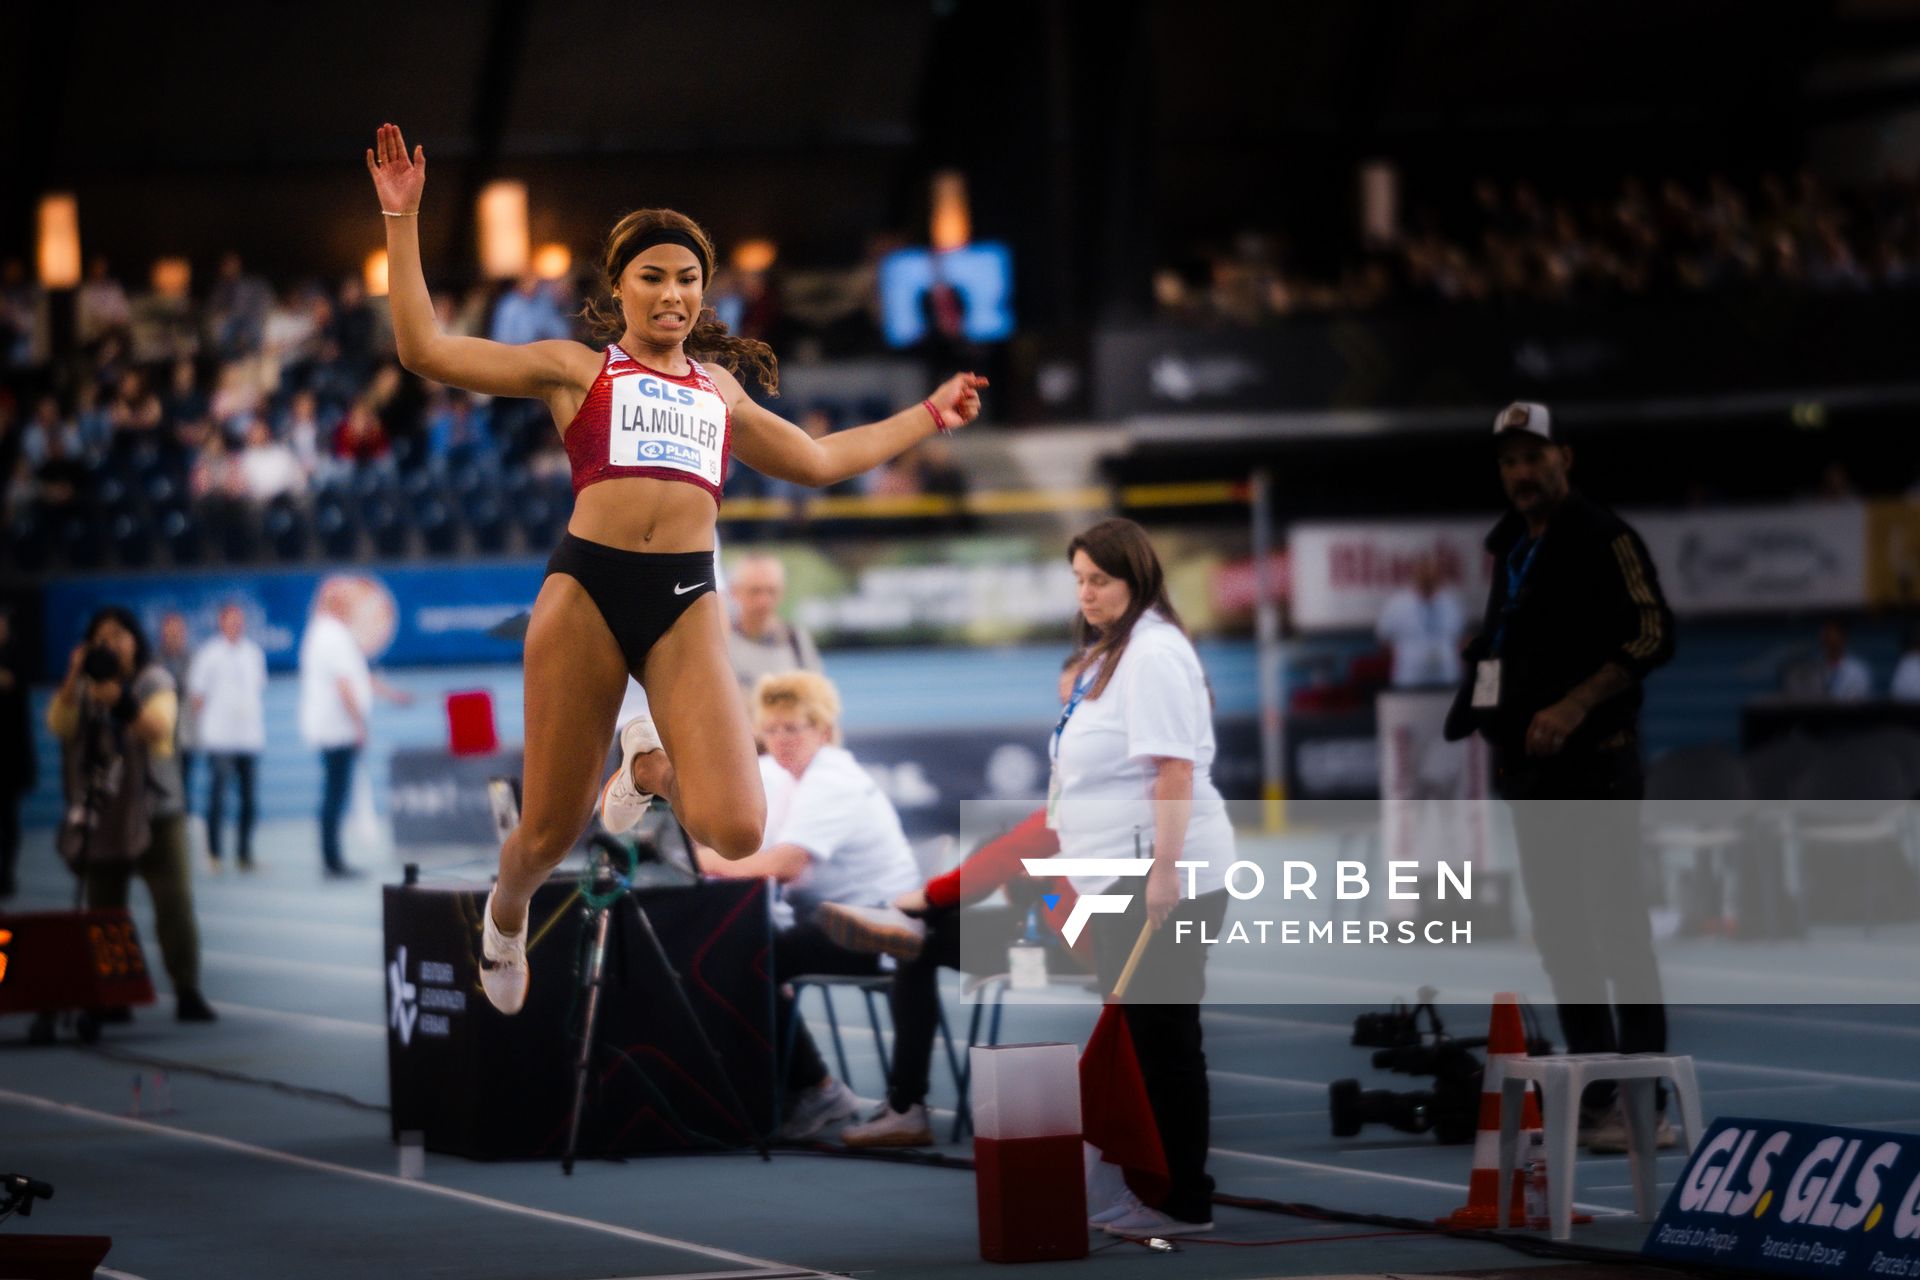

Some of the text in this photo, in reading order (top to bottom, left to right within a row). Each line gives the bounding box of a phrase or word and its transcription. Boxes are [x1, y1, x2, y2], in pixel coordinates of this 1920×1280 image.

[638, 378, 695, 406] GLS
[621, 404, 718, 451] LA.MÜLLER
[665, 444, 700, 463] PLAN
